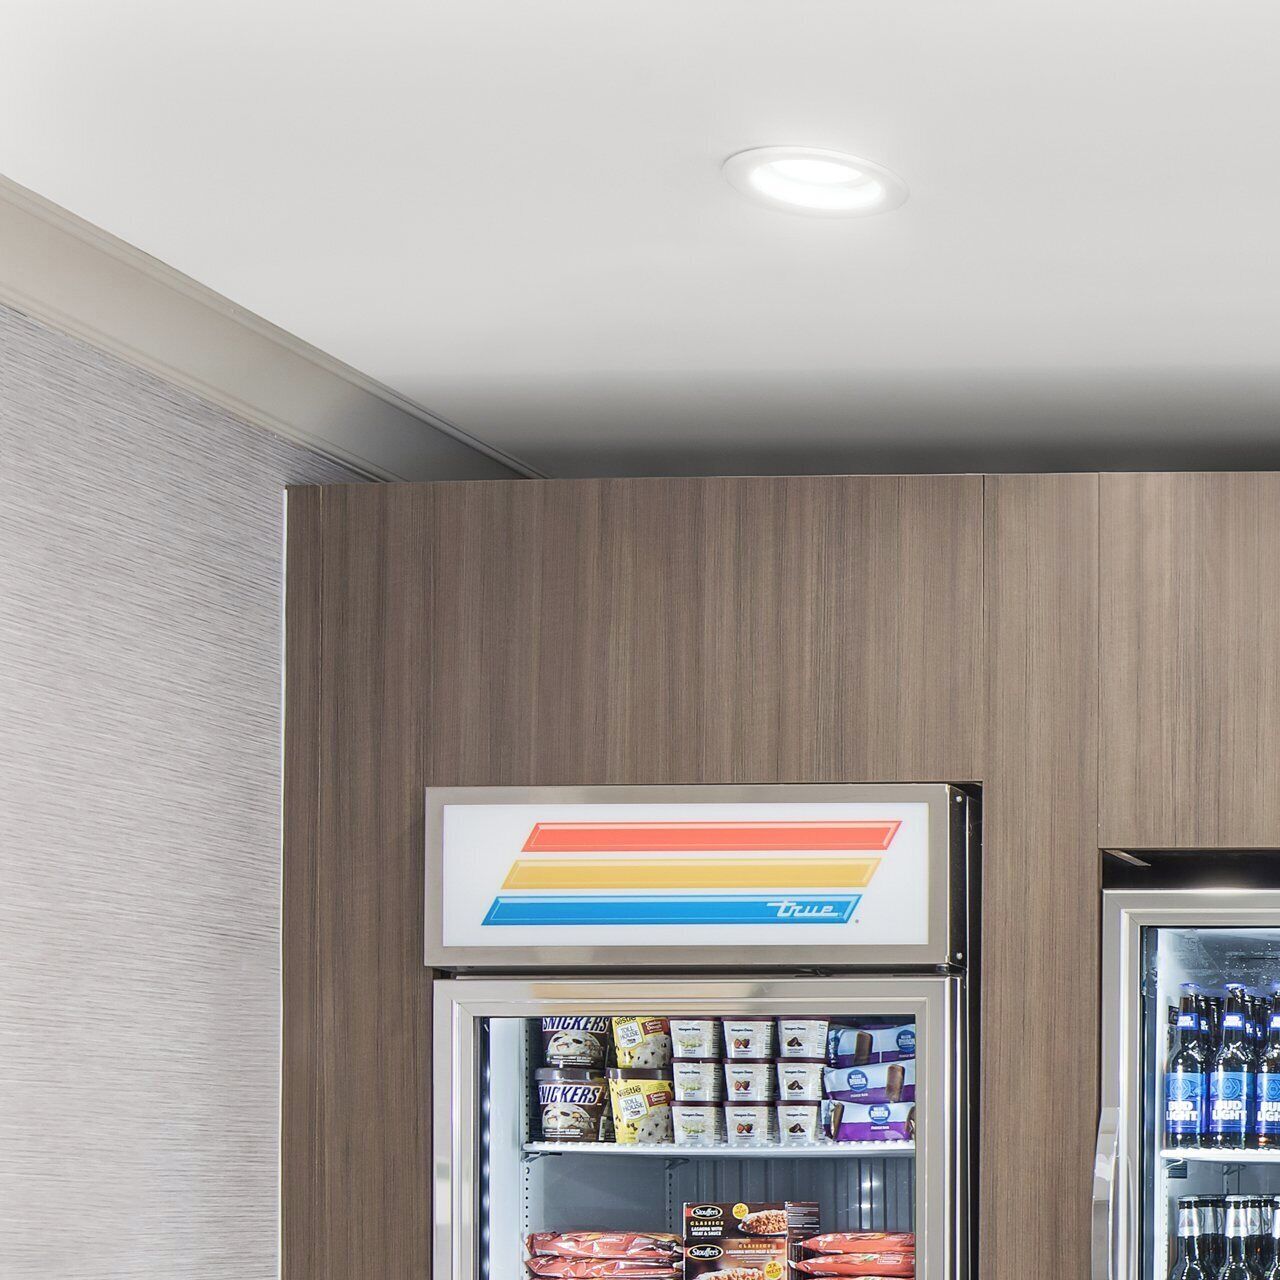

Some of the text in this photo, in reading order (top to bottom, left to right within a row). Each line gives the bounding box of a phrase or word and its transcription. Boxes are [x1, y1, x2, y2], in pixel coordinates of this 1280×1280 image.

[538, 1085, 601, 1105] NICKERS
[1168, 1101, 1193, 1111] BUD
[1166, 1110, 1199, 1121] LIGHT
